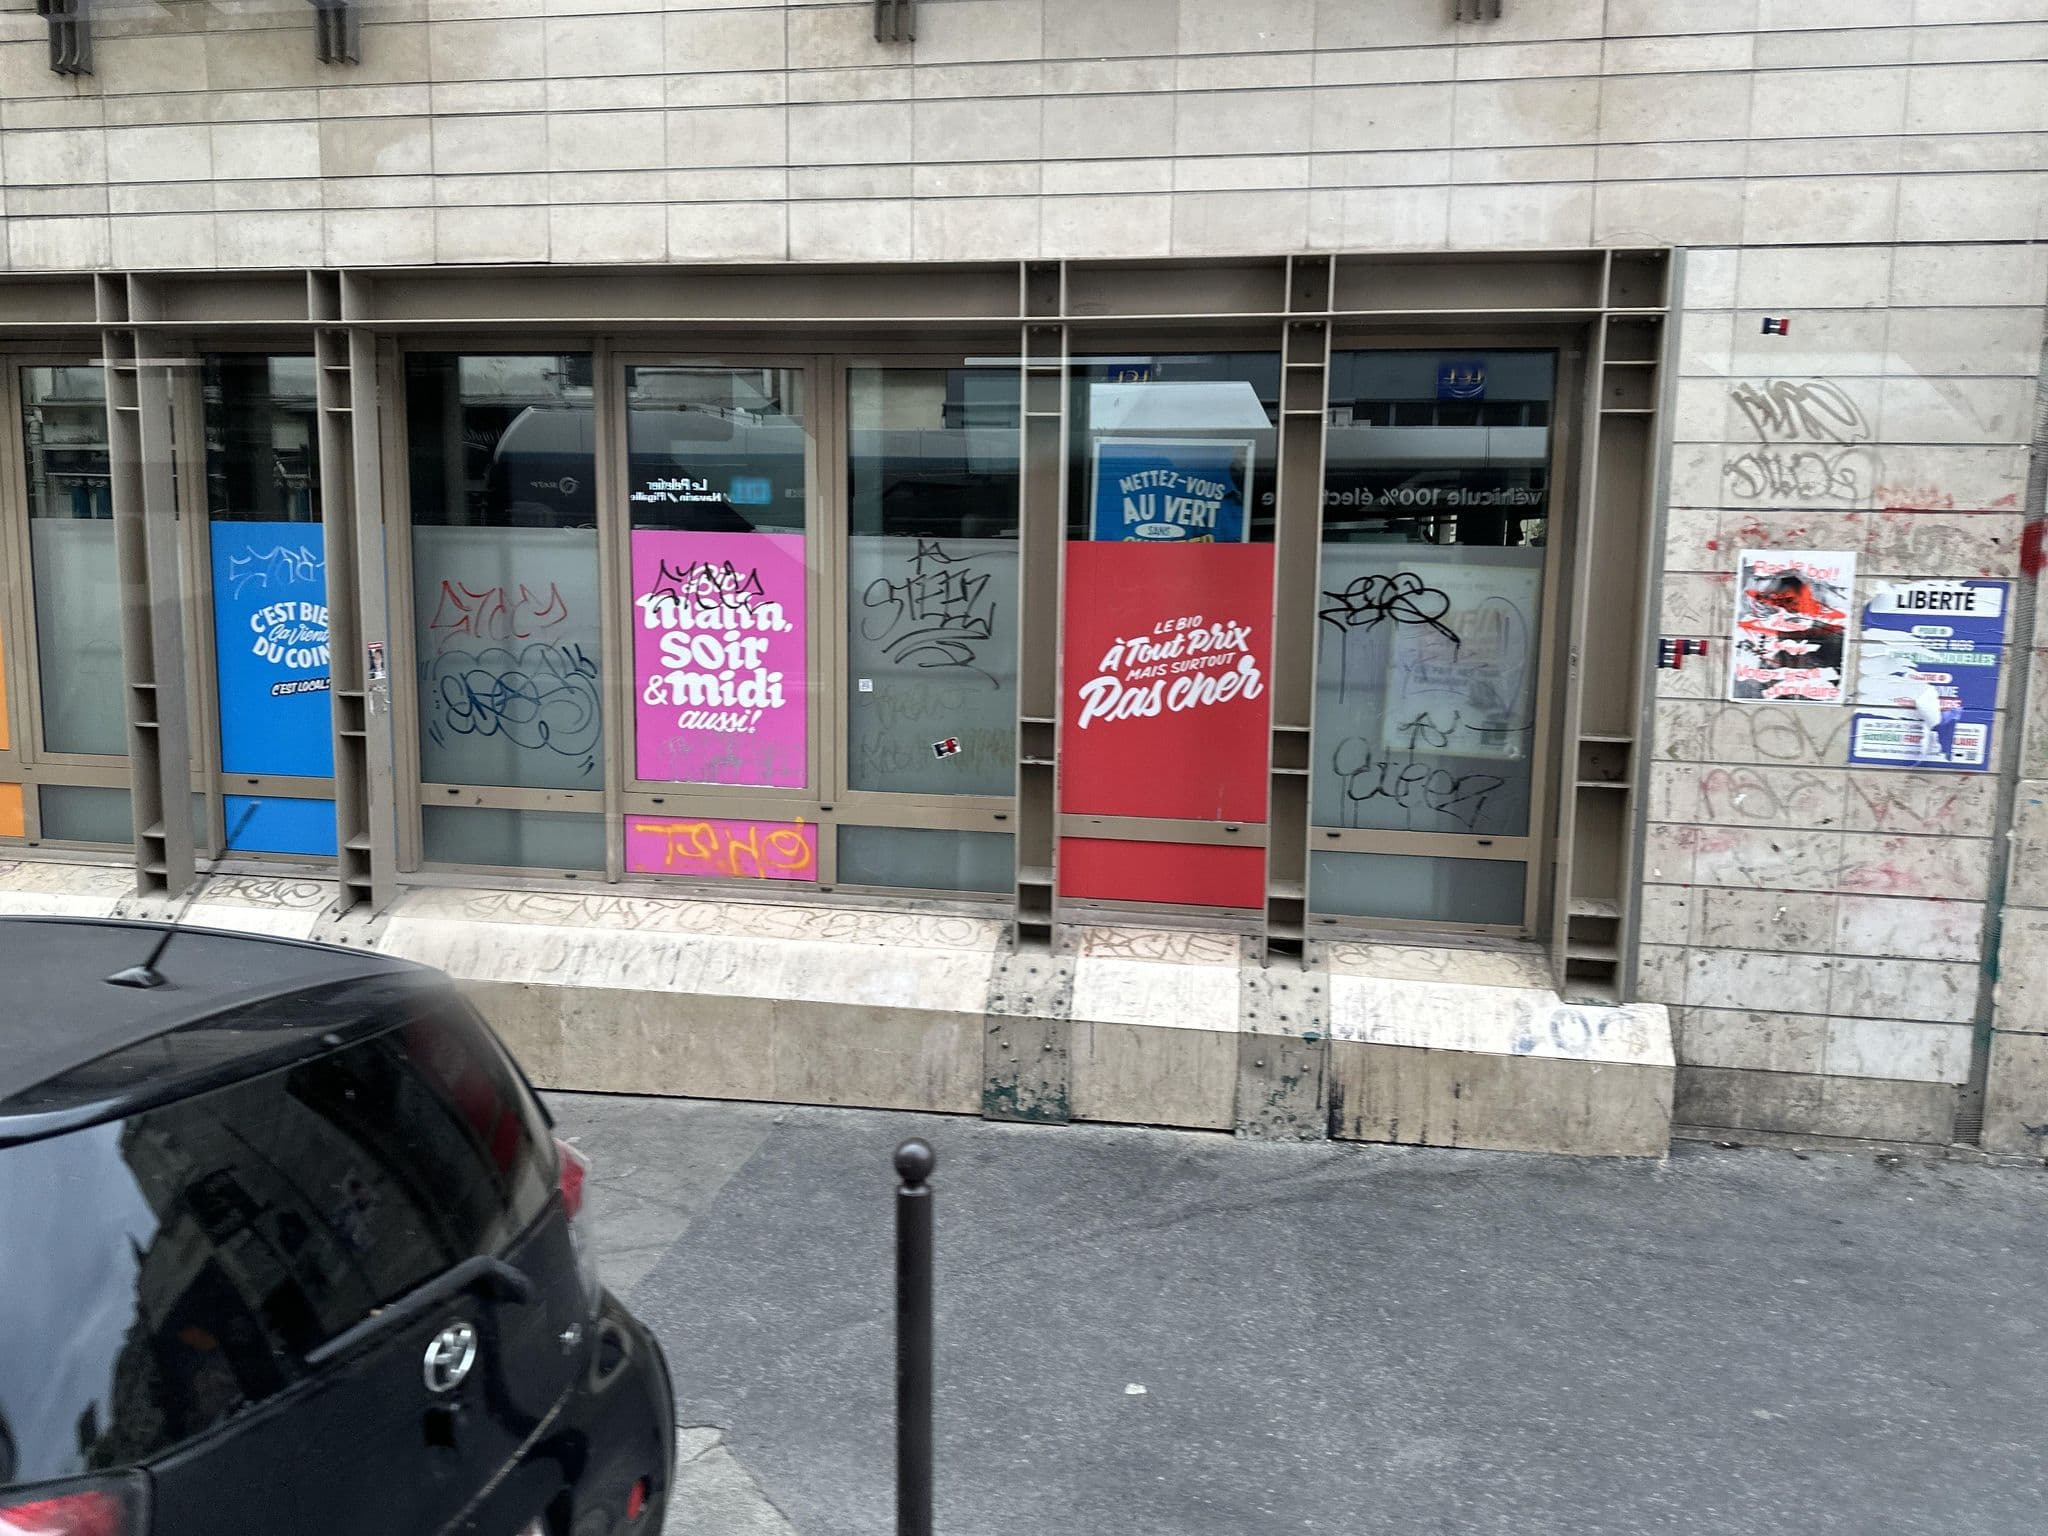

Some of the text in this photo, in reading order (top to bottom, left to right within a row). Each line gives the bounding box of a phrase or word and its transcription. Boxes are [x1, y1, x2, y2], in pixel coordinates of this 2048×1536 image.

[1119, 470, 1225, 499] METTEZ-VOUS
[1123, 494, 1220, 527] AU VERT
[250, 602, 296, 633] C'EST
[1153, 615, 1203, 634] LE BIO
[251, 636, 285, 664] DU
[660, 630, 768, 670] soir
[1099, 637, 1125, 672] À
[1125, 652, 1236, 681] MAIS SURTOUT
[643, 668, 786, 708] & midi
[678, 709, 763, 733] aussi!
